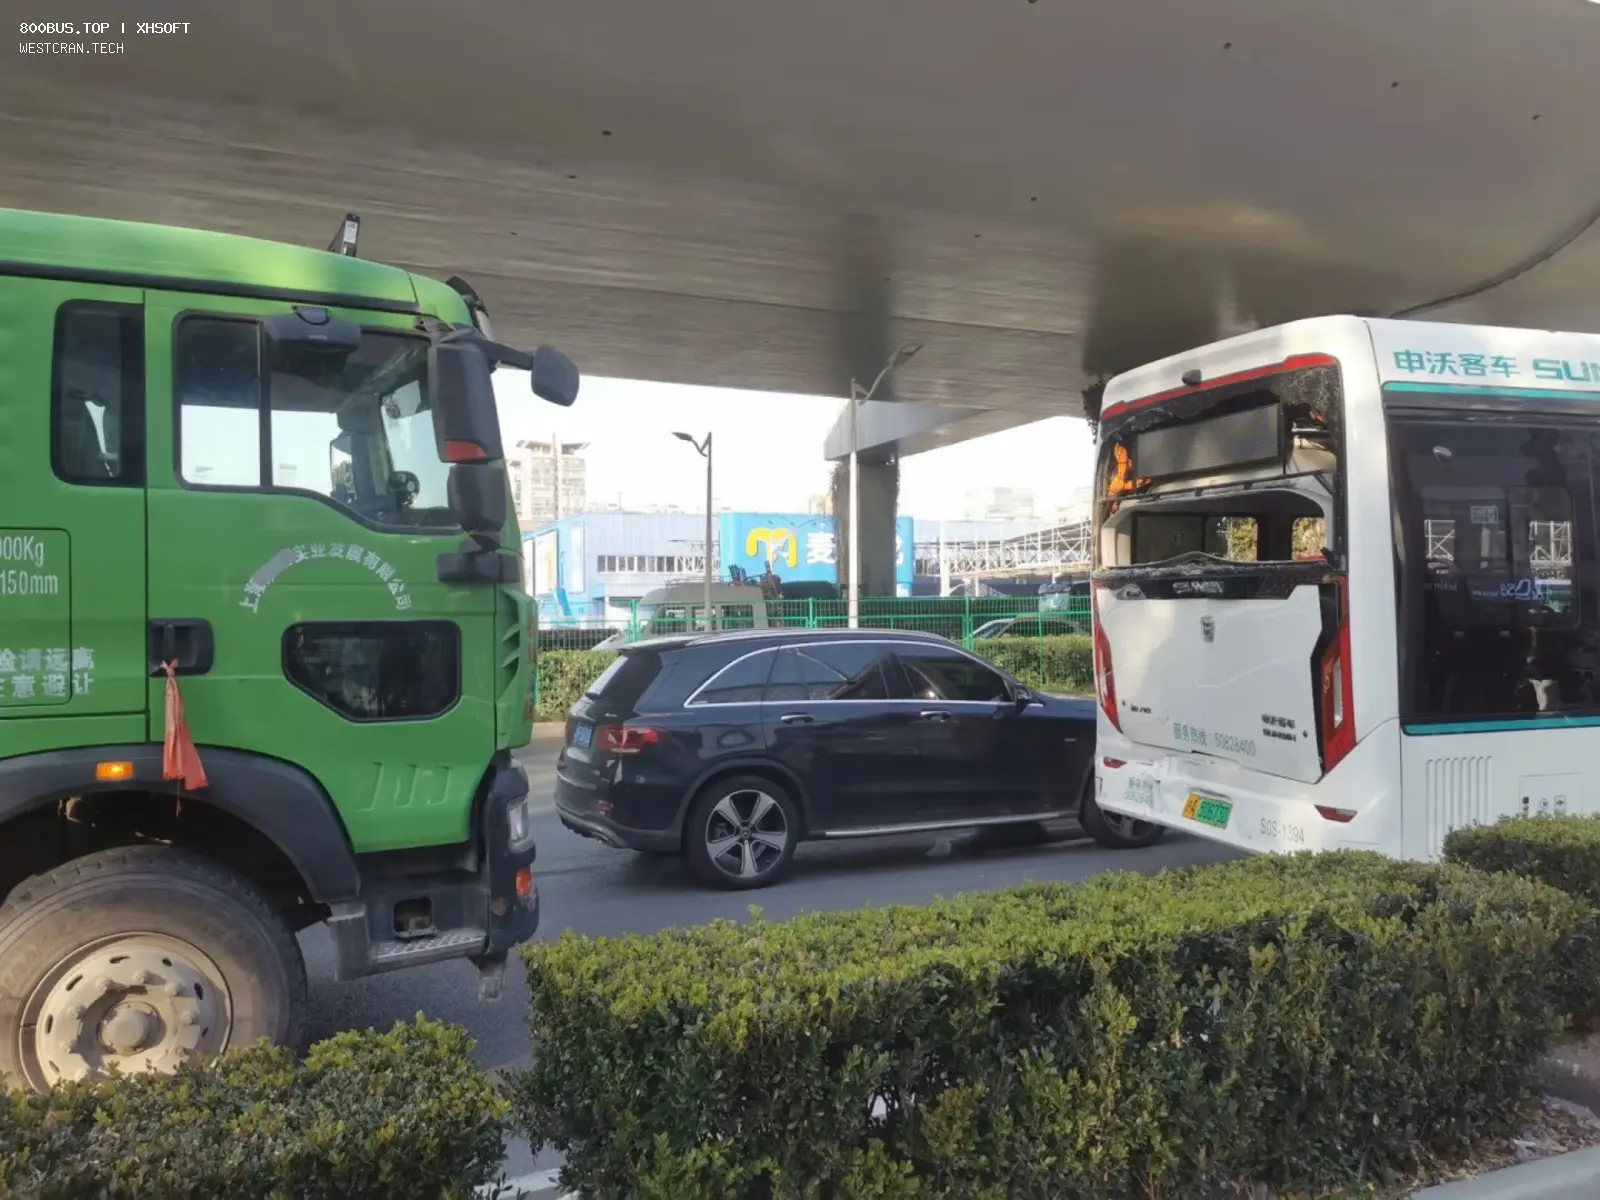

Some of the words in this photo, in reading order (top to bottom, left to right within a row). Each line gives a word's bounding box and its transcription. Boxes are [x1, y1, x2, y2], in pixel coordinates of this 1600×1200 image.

[1393, 349, 1521, 378] 申沃客车
[0, 535, 44, 568] 00Kg
[0, 569, 58, 595] 150mm
[0, 672, 95, 698] 意避让
